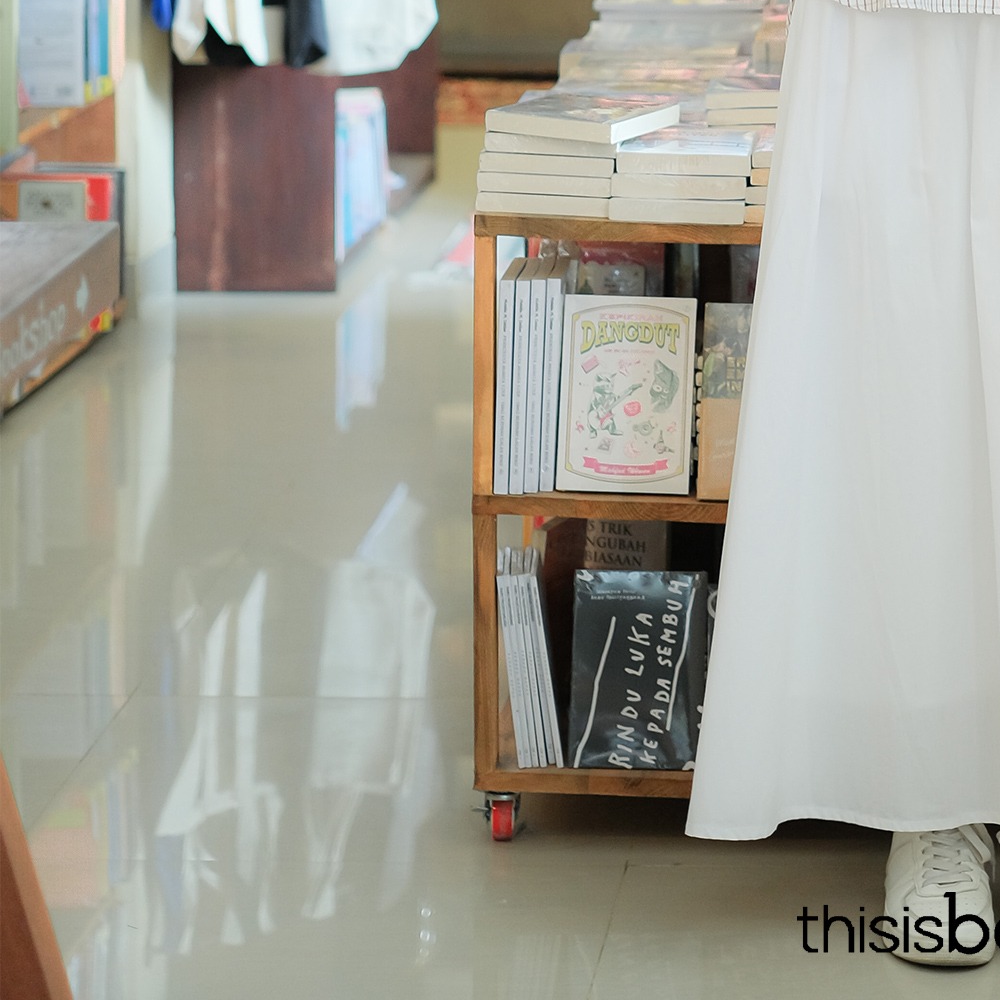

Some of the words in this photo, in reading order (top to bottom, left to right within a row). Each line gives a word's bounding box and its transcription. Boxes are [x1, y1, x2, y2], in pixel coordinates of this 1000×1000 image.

[580, 320, 681, 355] DANGDUT
[585, 551, 642, 567] BIASAAN
[586, 536, 646, 553] NGUBAH
[624, 612, 654, 677] LUKA
[639, 678, 672, 765] KEPADA
[656, 579, 690, 668] SEMBUH
[607, 688, 642, 770] RINDU
